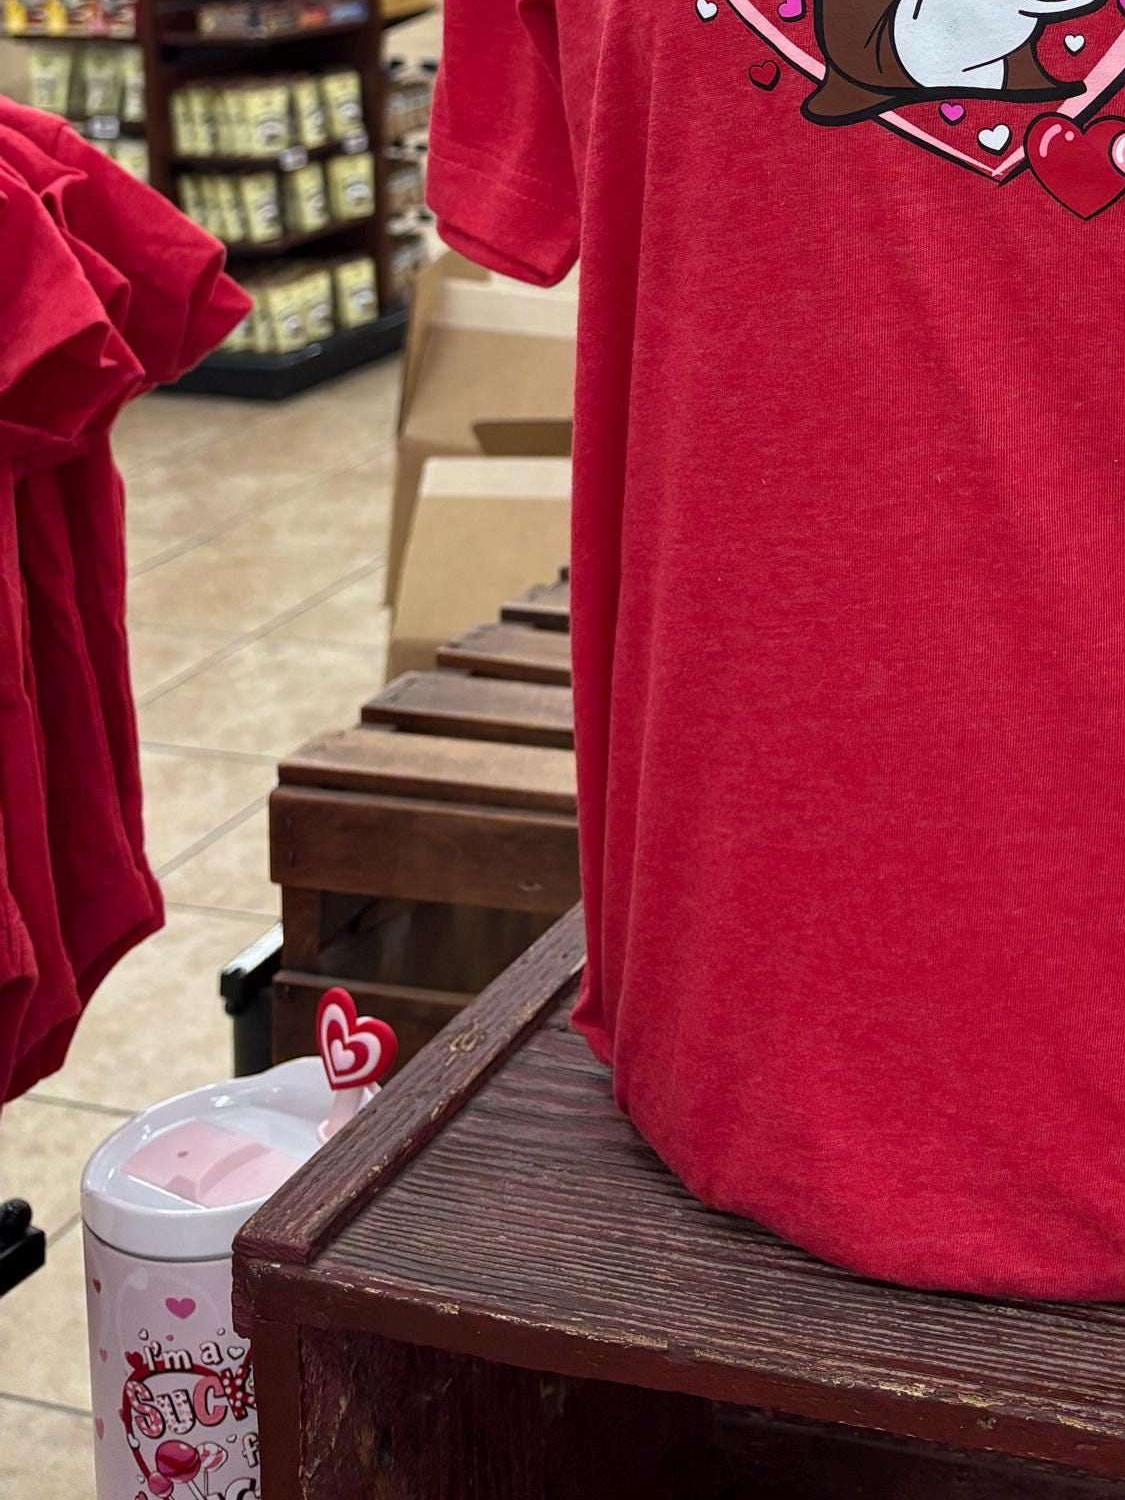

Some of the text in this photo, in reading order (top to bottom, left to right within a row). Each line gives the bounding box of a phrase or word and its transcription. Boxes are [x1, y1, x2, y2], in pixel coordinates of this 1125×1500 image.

[142, 1341, 223, 1371] I'm a
[127, 1367, 257, 1438] SUCK
